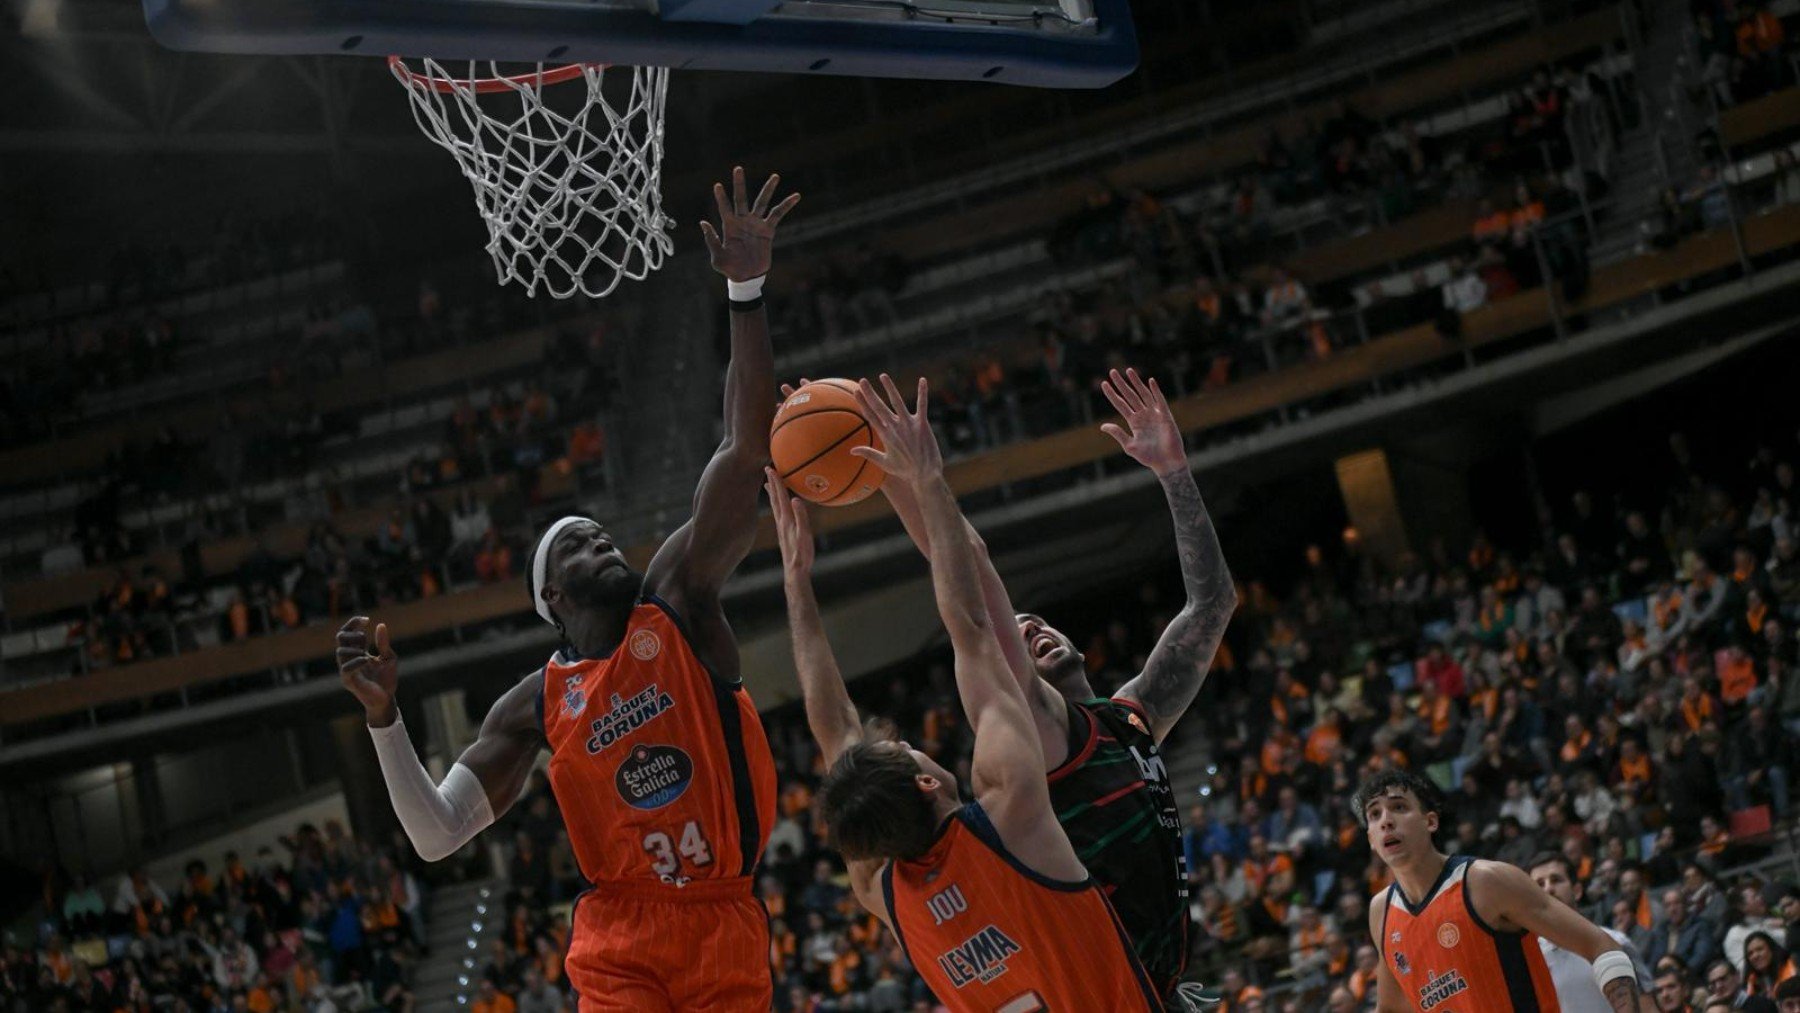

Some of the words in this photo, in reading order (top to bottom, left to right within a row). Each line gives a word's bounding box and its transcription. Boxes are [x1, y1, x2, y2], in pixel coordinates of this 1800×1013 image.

[592, 684, 657, 732] BASQUET
[623, 754, 676, 786] Estrella
[630, 769, 681, 798] Galicia
[643, 821, 713, 876] 34
[926, 884, 968, 926] JOU
[938, 925, 1021, 988] LEYMA
